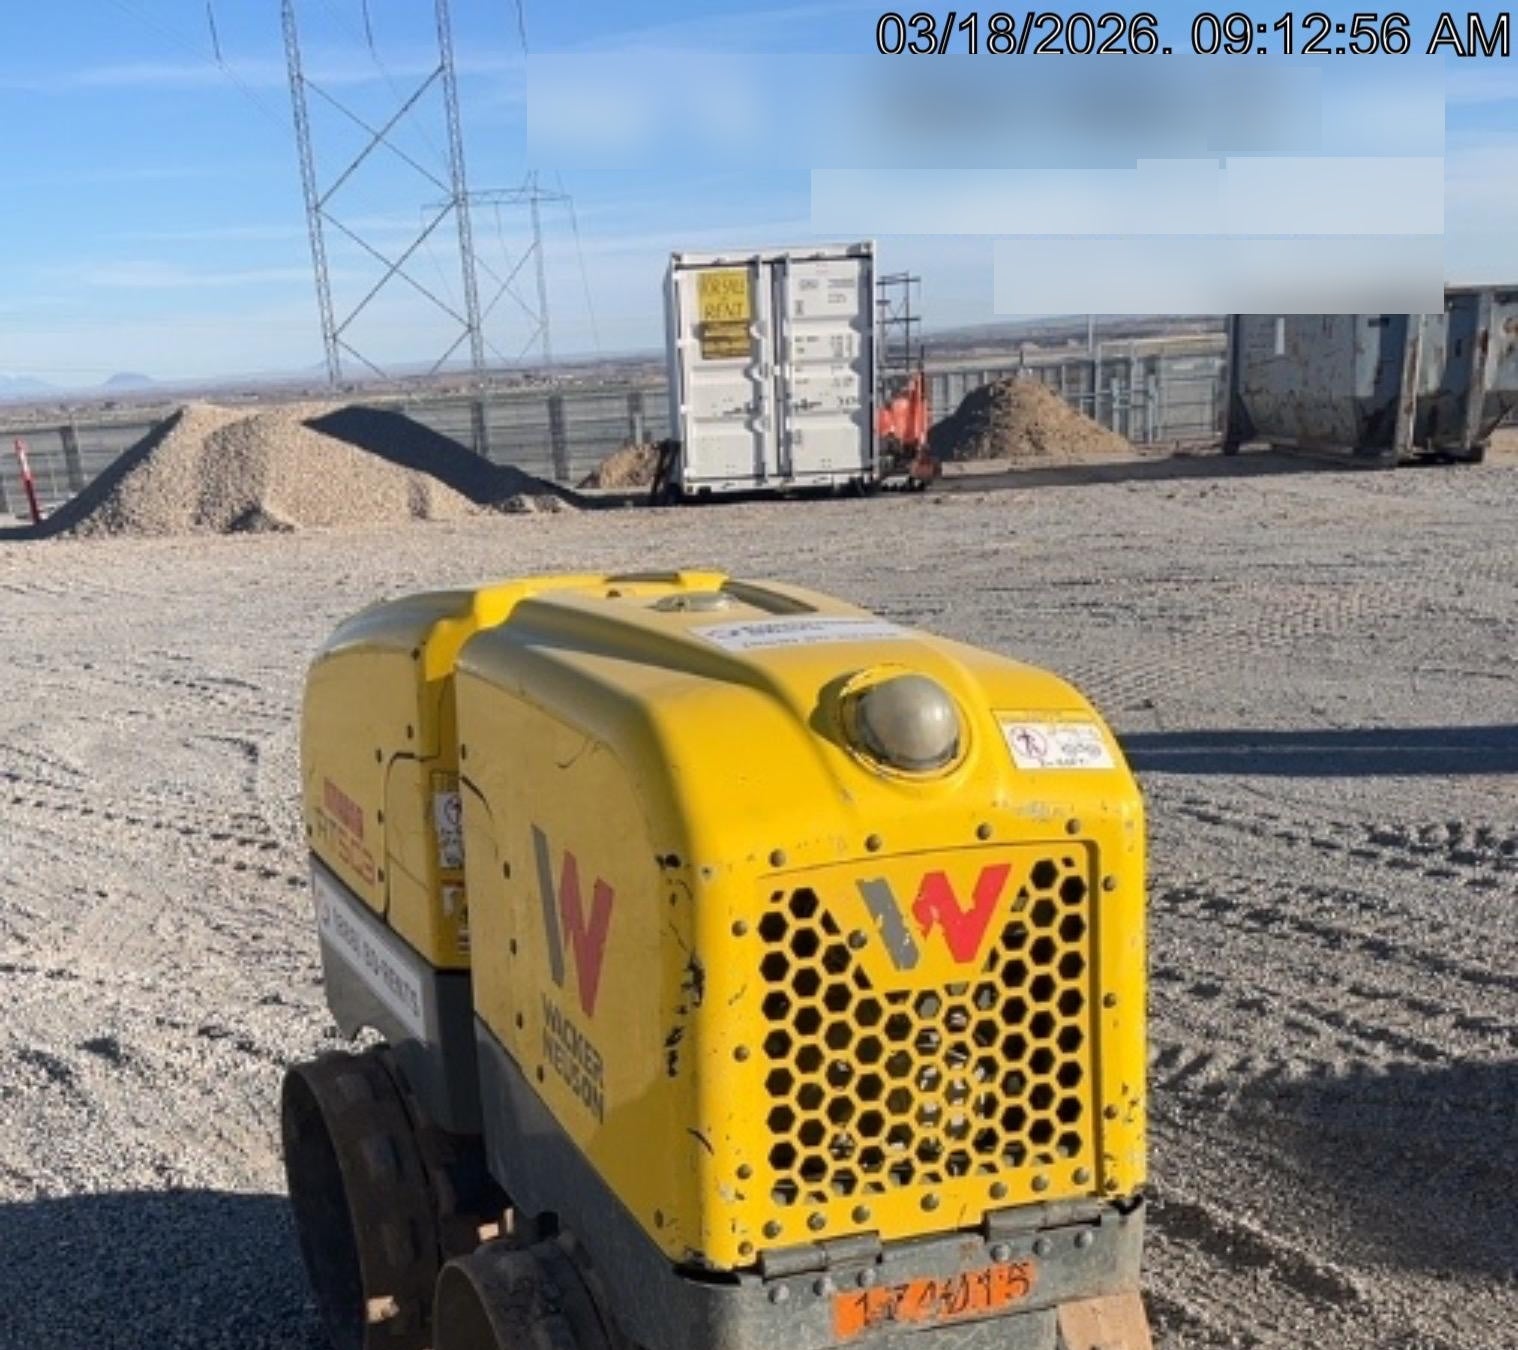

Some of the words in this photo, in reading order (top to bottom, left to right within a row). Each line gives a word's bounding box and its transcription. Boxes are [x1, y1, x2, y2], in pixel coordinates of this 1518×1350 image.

[704, 302, 742, 320] RENT
[541, 991, 605, 1089] WACKER
[543, 1026, 605, 1126] NEUSON
